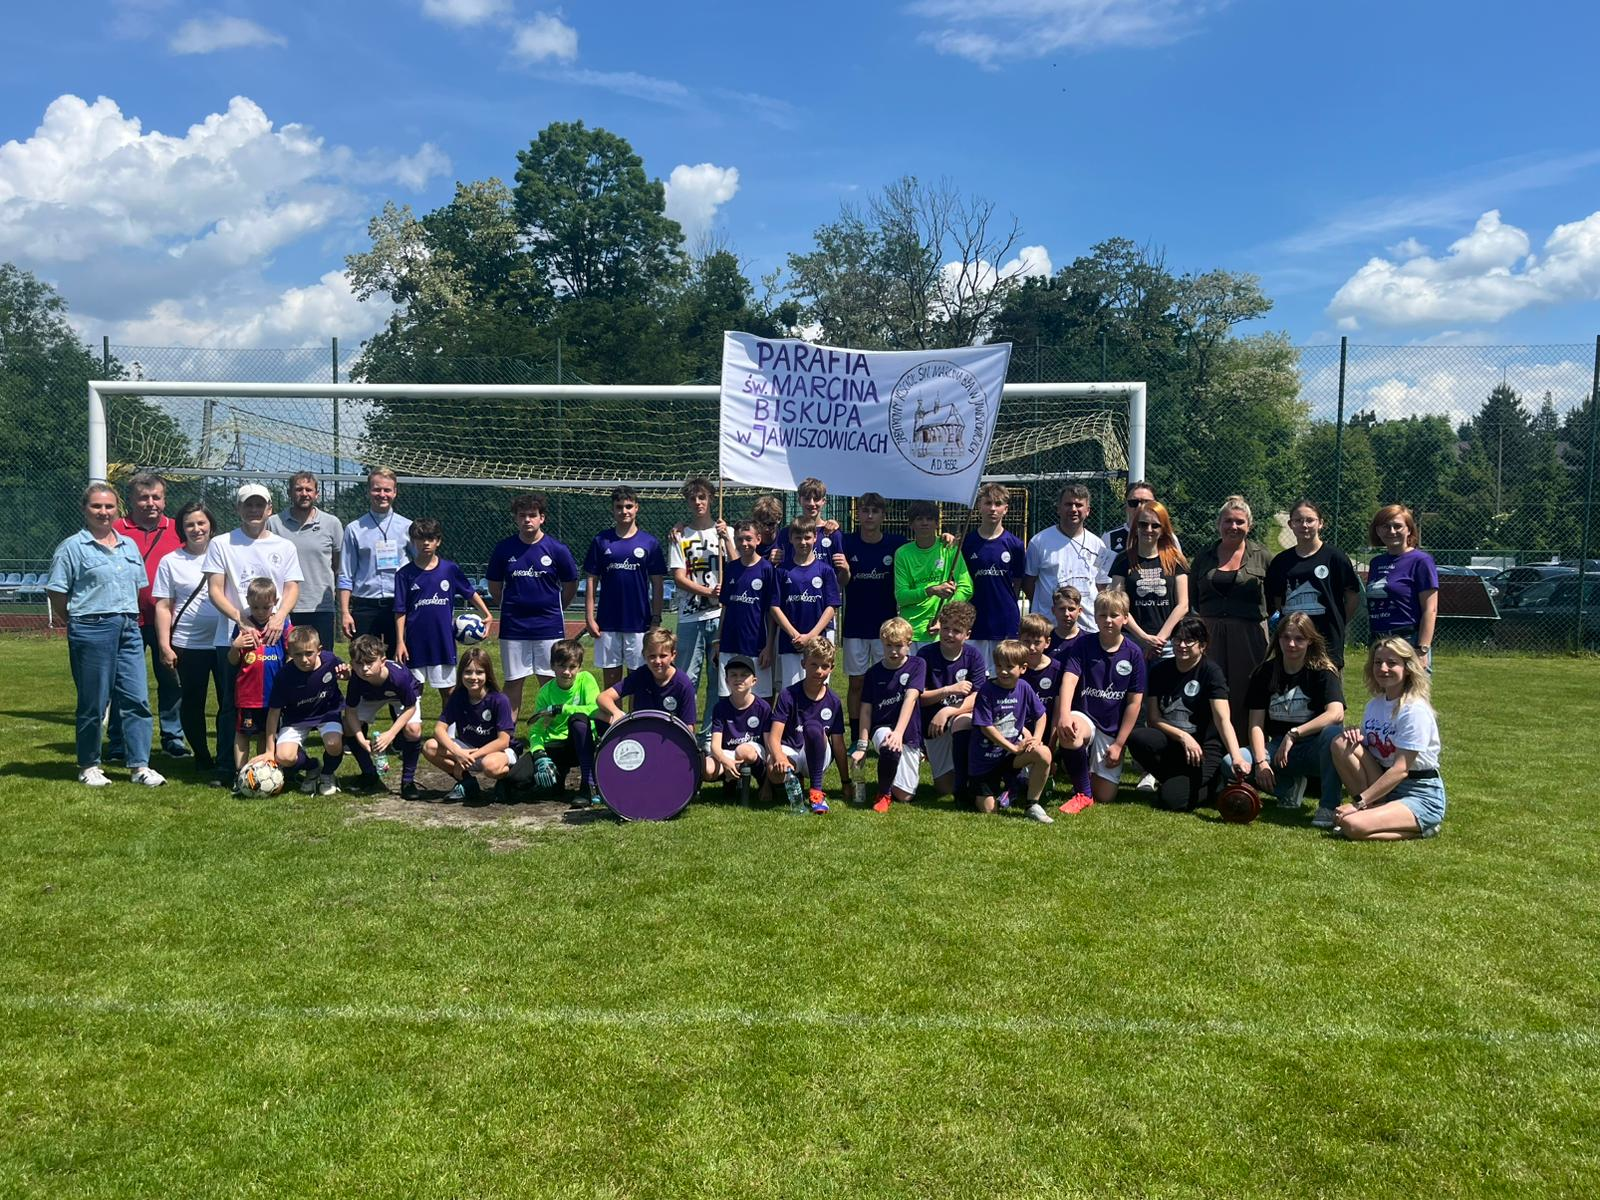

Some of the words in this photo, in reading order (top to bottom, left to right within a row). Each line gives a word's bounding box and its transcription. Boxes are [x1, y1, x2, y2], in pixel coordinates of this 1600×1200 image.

[756, 341, 871, 377] PARAFIA
[742, 373, 768, 395] św.
[771, 374, 880, 404] MARCINA
[754, 398, 862, 428] BISKUPA
[750, 424, 888, 458] JAWISZOWICACH
